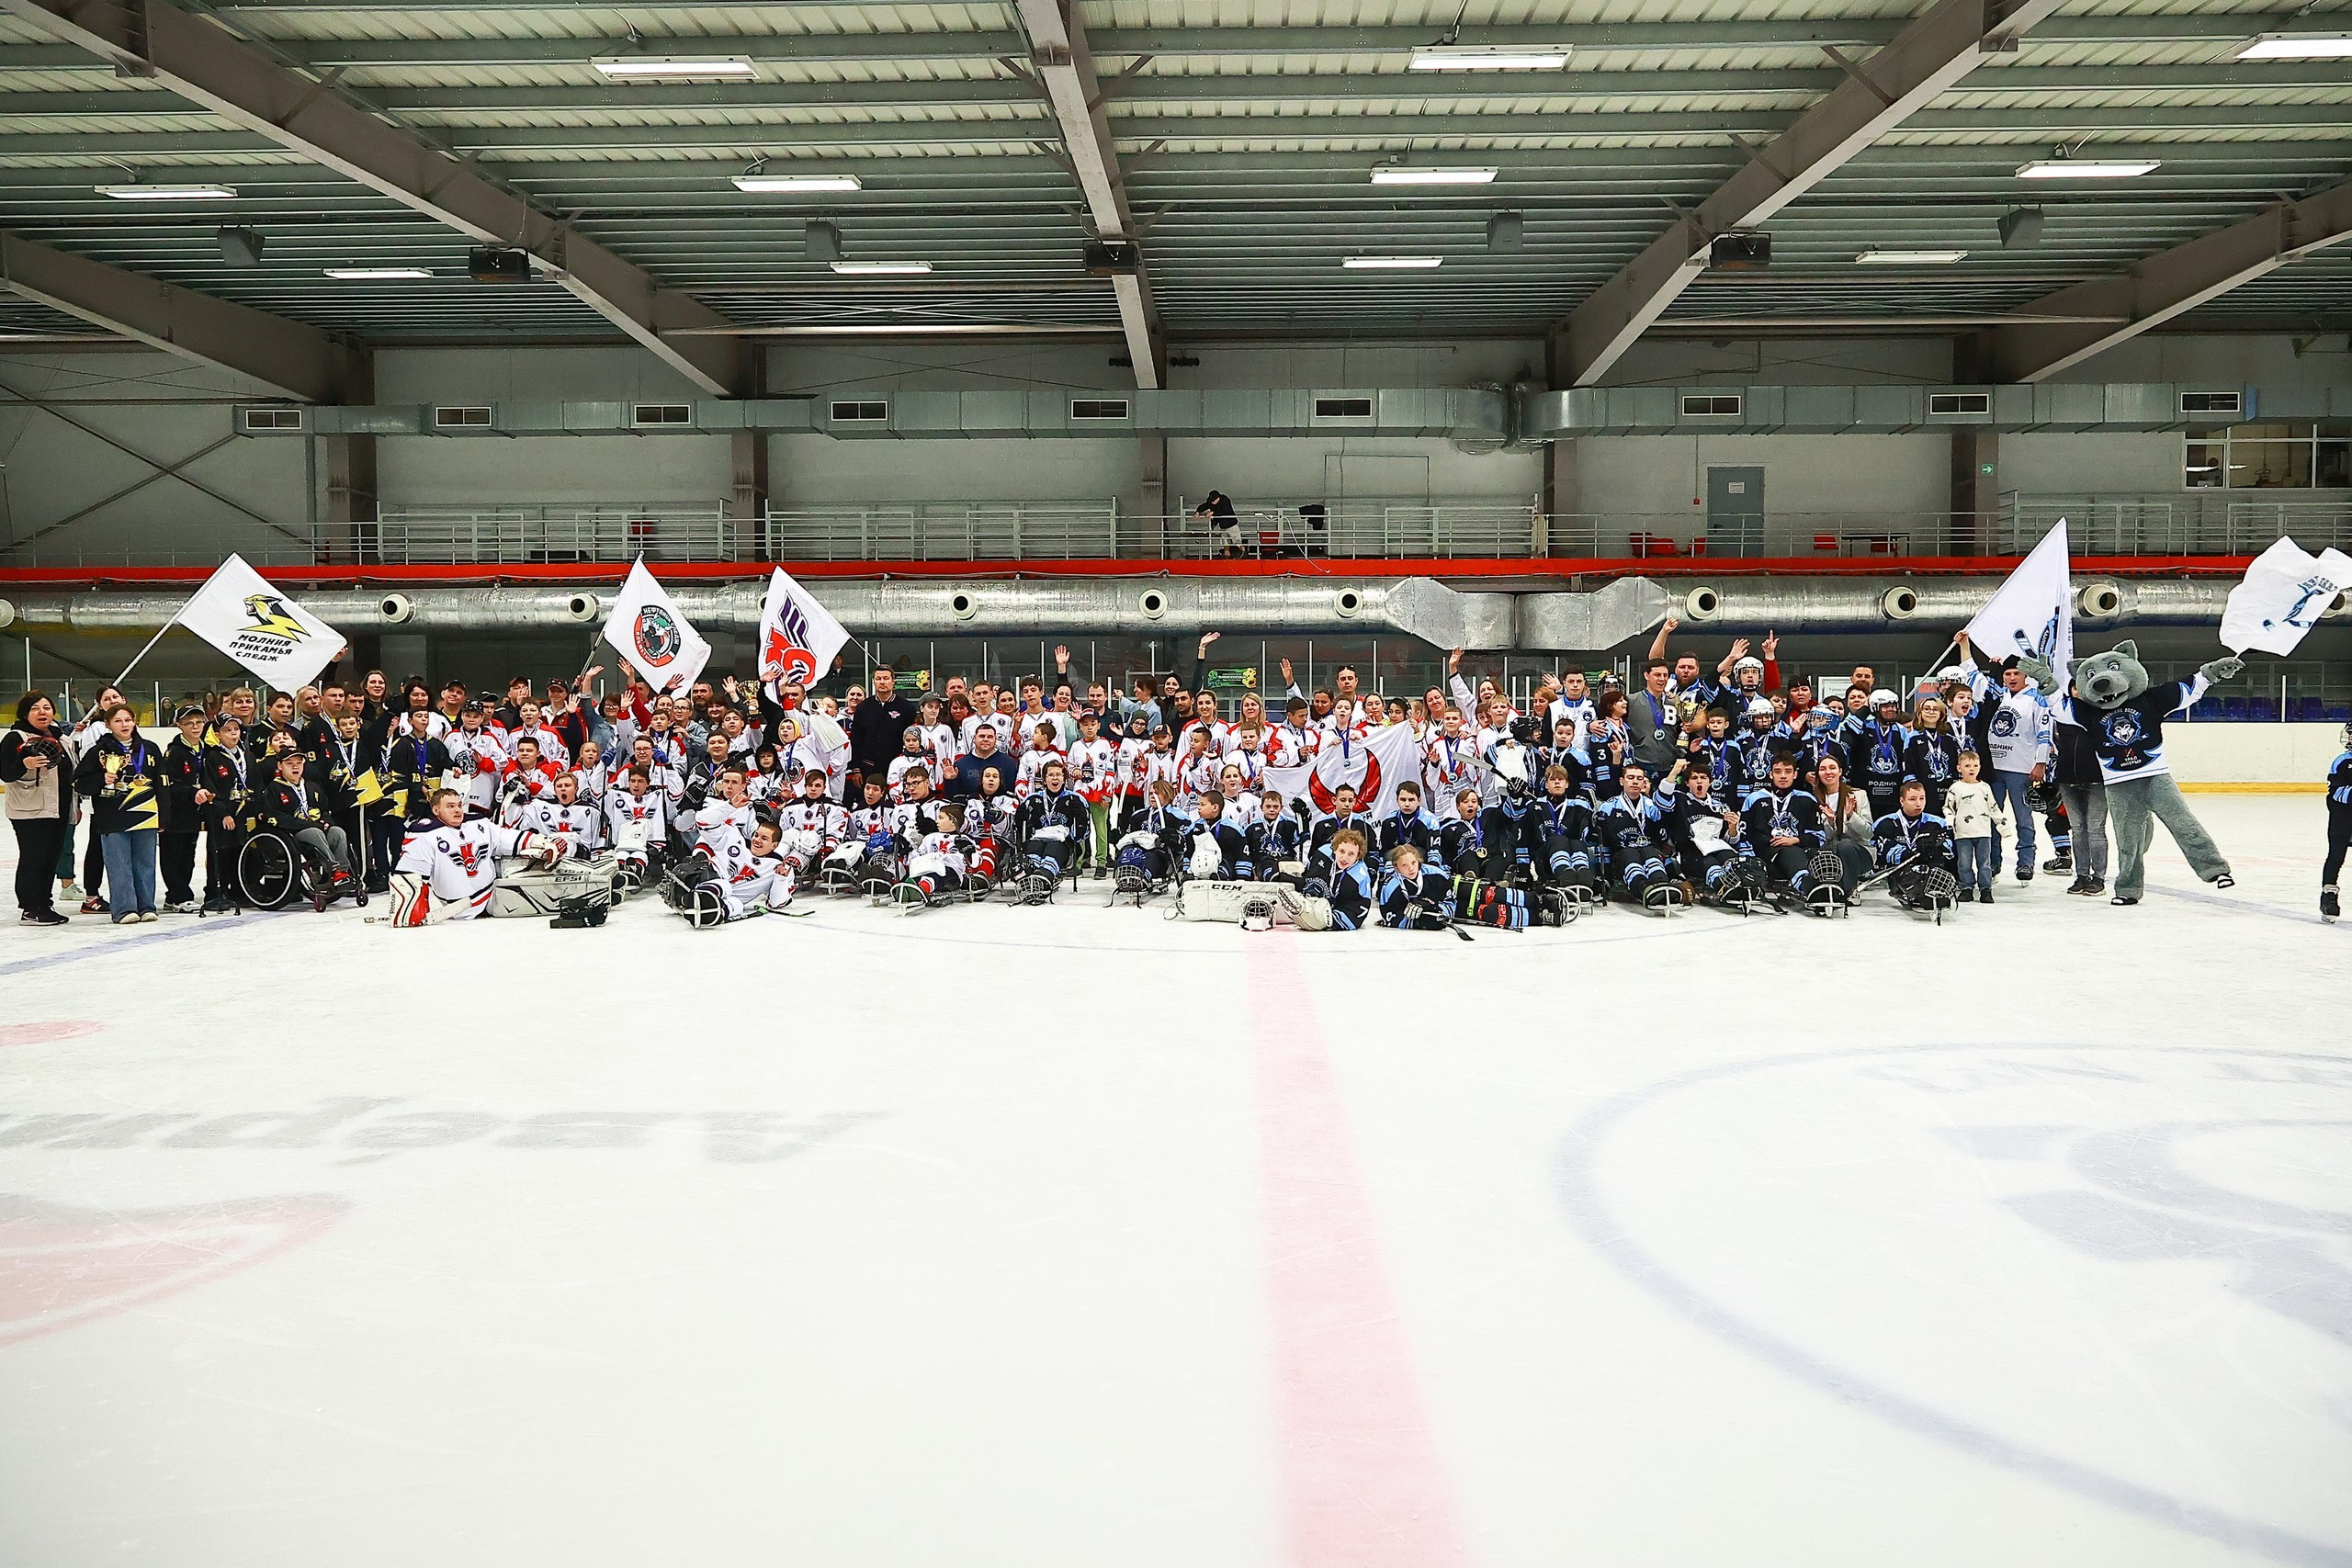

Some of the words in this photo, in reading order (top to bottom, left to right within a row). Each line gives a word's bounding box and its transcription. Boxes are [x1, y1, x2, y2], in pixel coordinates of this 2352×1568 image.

[238, 634, 292, 647] МОЛНИЯ
[229, 641, 293, 655] ПРИКАМЬЯ
[235, 650, 279, 661] СЛЕДЖ
[2041, 714, 2050, 725] 9
[1597, 749, 1607, 761] 3
[1430, 836, 1442, 846] 14
[1243, 844, 1250, 856] 4
